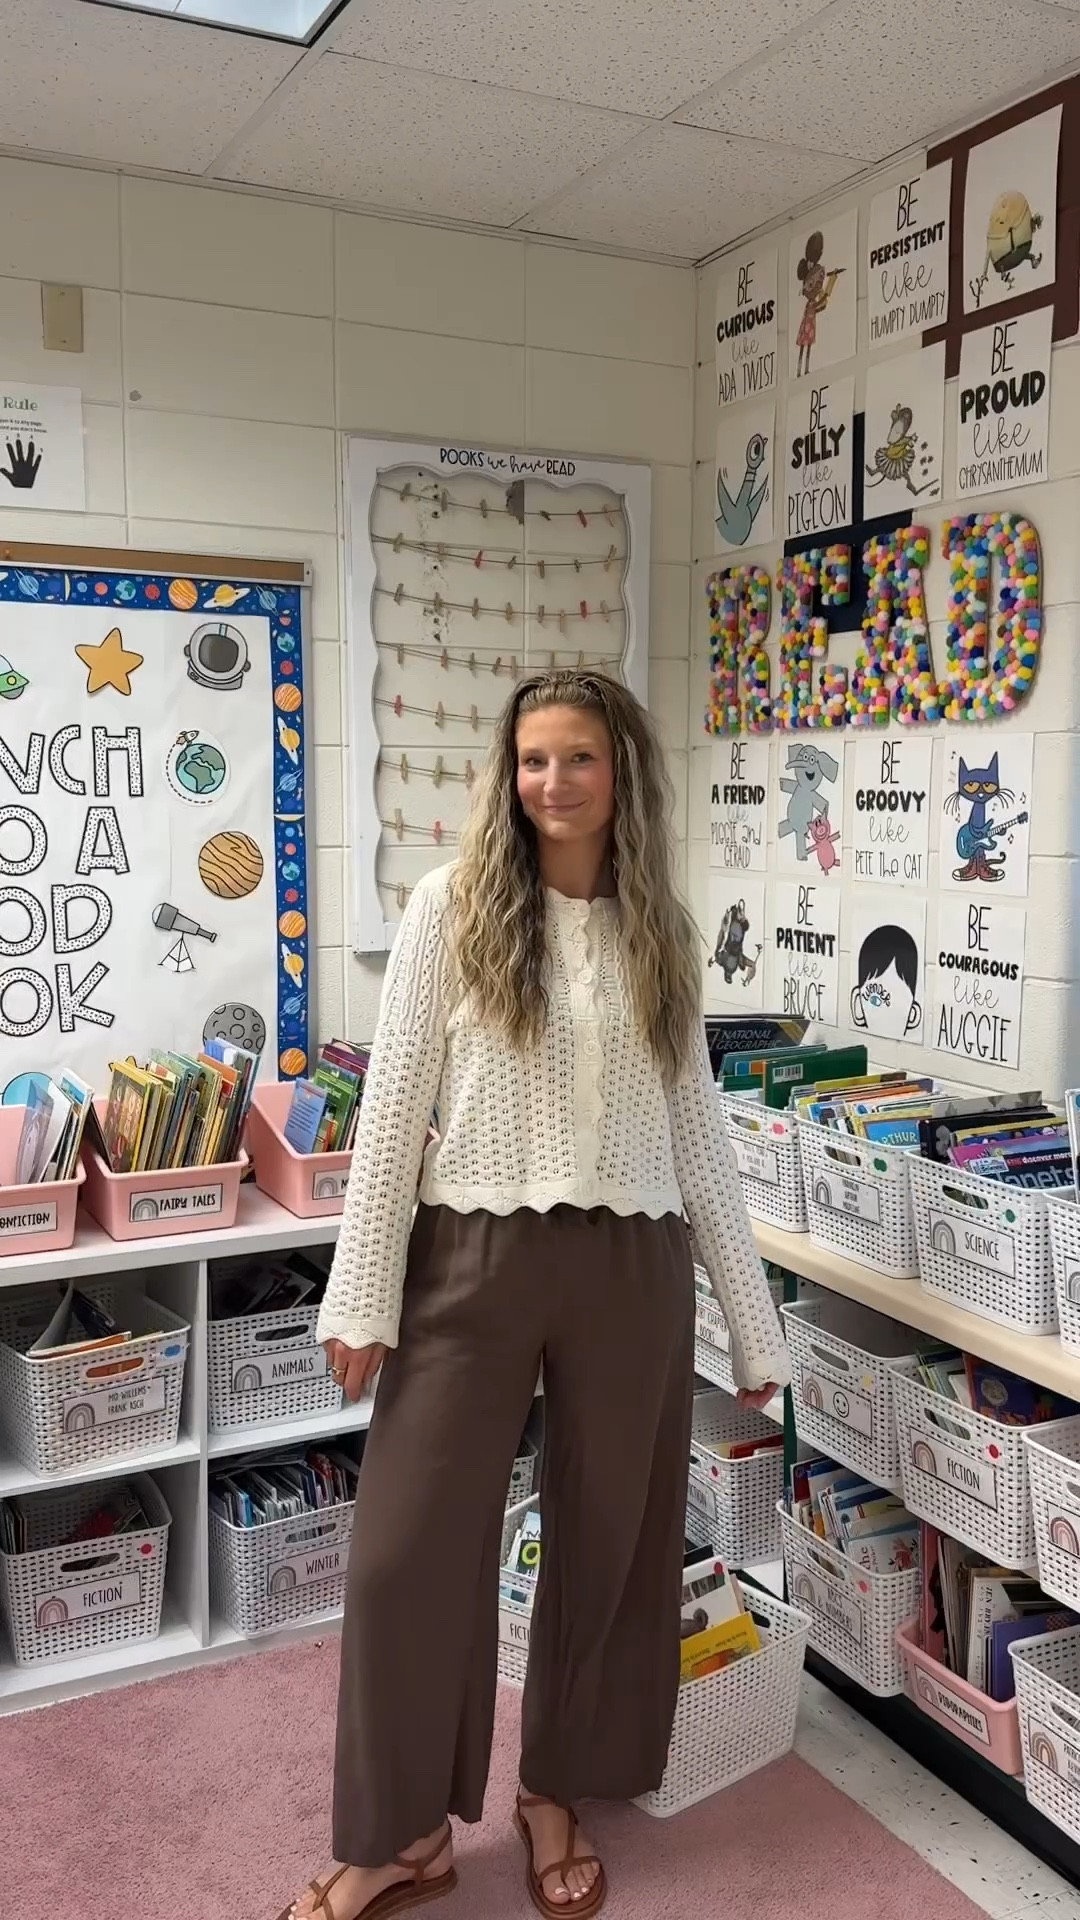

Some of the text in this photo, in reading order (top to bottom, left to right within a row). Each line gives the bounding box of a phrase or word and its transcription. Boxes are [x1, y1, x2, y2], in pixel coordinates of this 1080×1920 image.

[896, 177, 921, 232] BE
[870, 220, 946, 269] PERSISTENT
[737, 261, 755, 308] BE
[881, 261, 933, 303] like
[716, 299, 775, 343] CURIOUS
[871, 289, 946, 341] HUMPTY DUMPTY
[731, 337, 760, 363] like
[991, 320, 1018, 376] BE
[718, 351, 776, 406] ADA TWIST
[3, 396, 38, 411] Rule
[810, 385, 830, 433] BE
[960, 370, 1046, 424] PROUD
[791, 423, 846, 469] SILLY
[973, 416, 1031, 458] like
[440, 447, 576, 476] BOOKS we have READ
[802, 461, 833, 488] like
[958, 449, 1043, 490] CHRYSANTHEMUM
[788, 484, 847, 537] PIGEON
[705, 511, 1042, 736] READ
[730, 741, 748, 780] BE
[881, 740, 903, 784] BE
[711, 783, 765, 805] A FRIEND
[855, 789, 926, 813] GROOVY
[75, 805, 131, 875] A
[711, 821, 762, 846] PIGGIE and
[869, 815, 910, 843] like
[723, 844, 751, 868] GERALD
[855, 849, 874, 875] PETE
[903, 853, 922, 880] CAT
[797, 885, 816, 926] BE
[776, 926, 836, 958] PATIENT
[968, 903, 992, 951] BE
[788, 951, 823, 980] like
[938, 951, 1019, 981] COURAGOUS
[0, 961, 115, 1037] OK
[783, 977, 826, 1021] BRUCE
[953, 975, 1000, 1009] like
[716, 1040, 781, 1051] GEOGRAPHIC
[721, 1029, 772, 1040] NATIONAL
[937, 1003, 1012, 1062] AUGGIE
[878, 1131, 917, 1145] RTHUR
[160, 1193, 216, 1211] FAIRY TALES
[965, 1231, 999, 1261] SCIENCE
[699, 1323, 715, 1344] BOOKS
[272, 1356, 314, 1379] ANIMALS
[947, 1457, 980, 1491] FICTION
[305, 1552, 340, 1576] WINTER
[83, 1586, 123, 1608] FICTION
